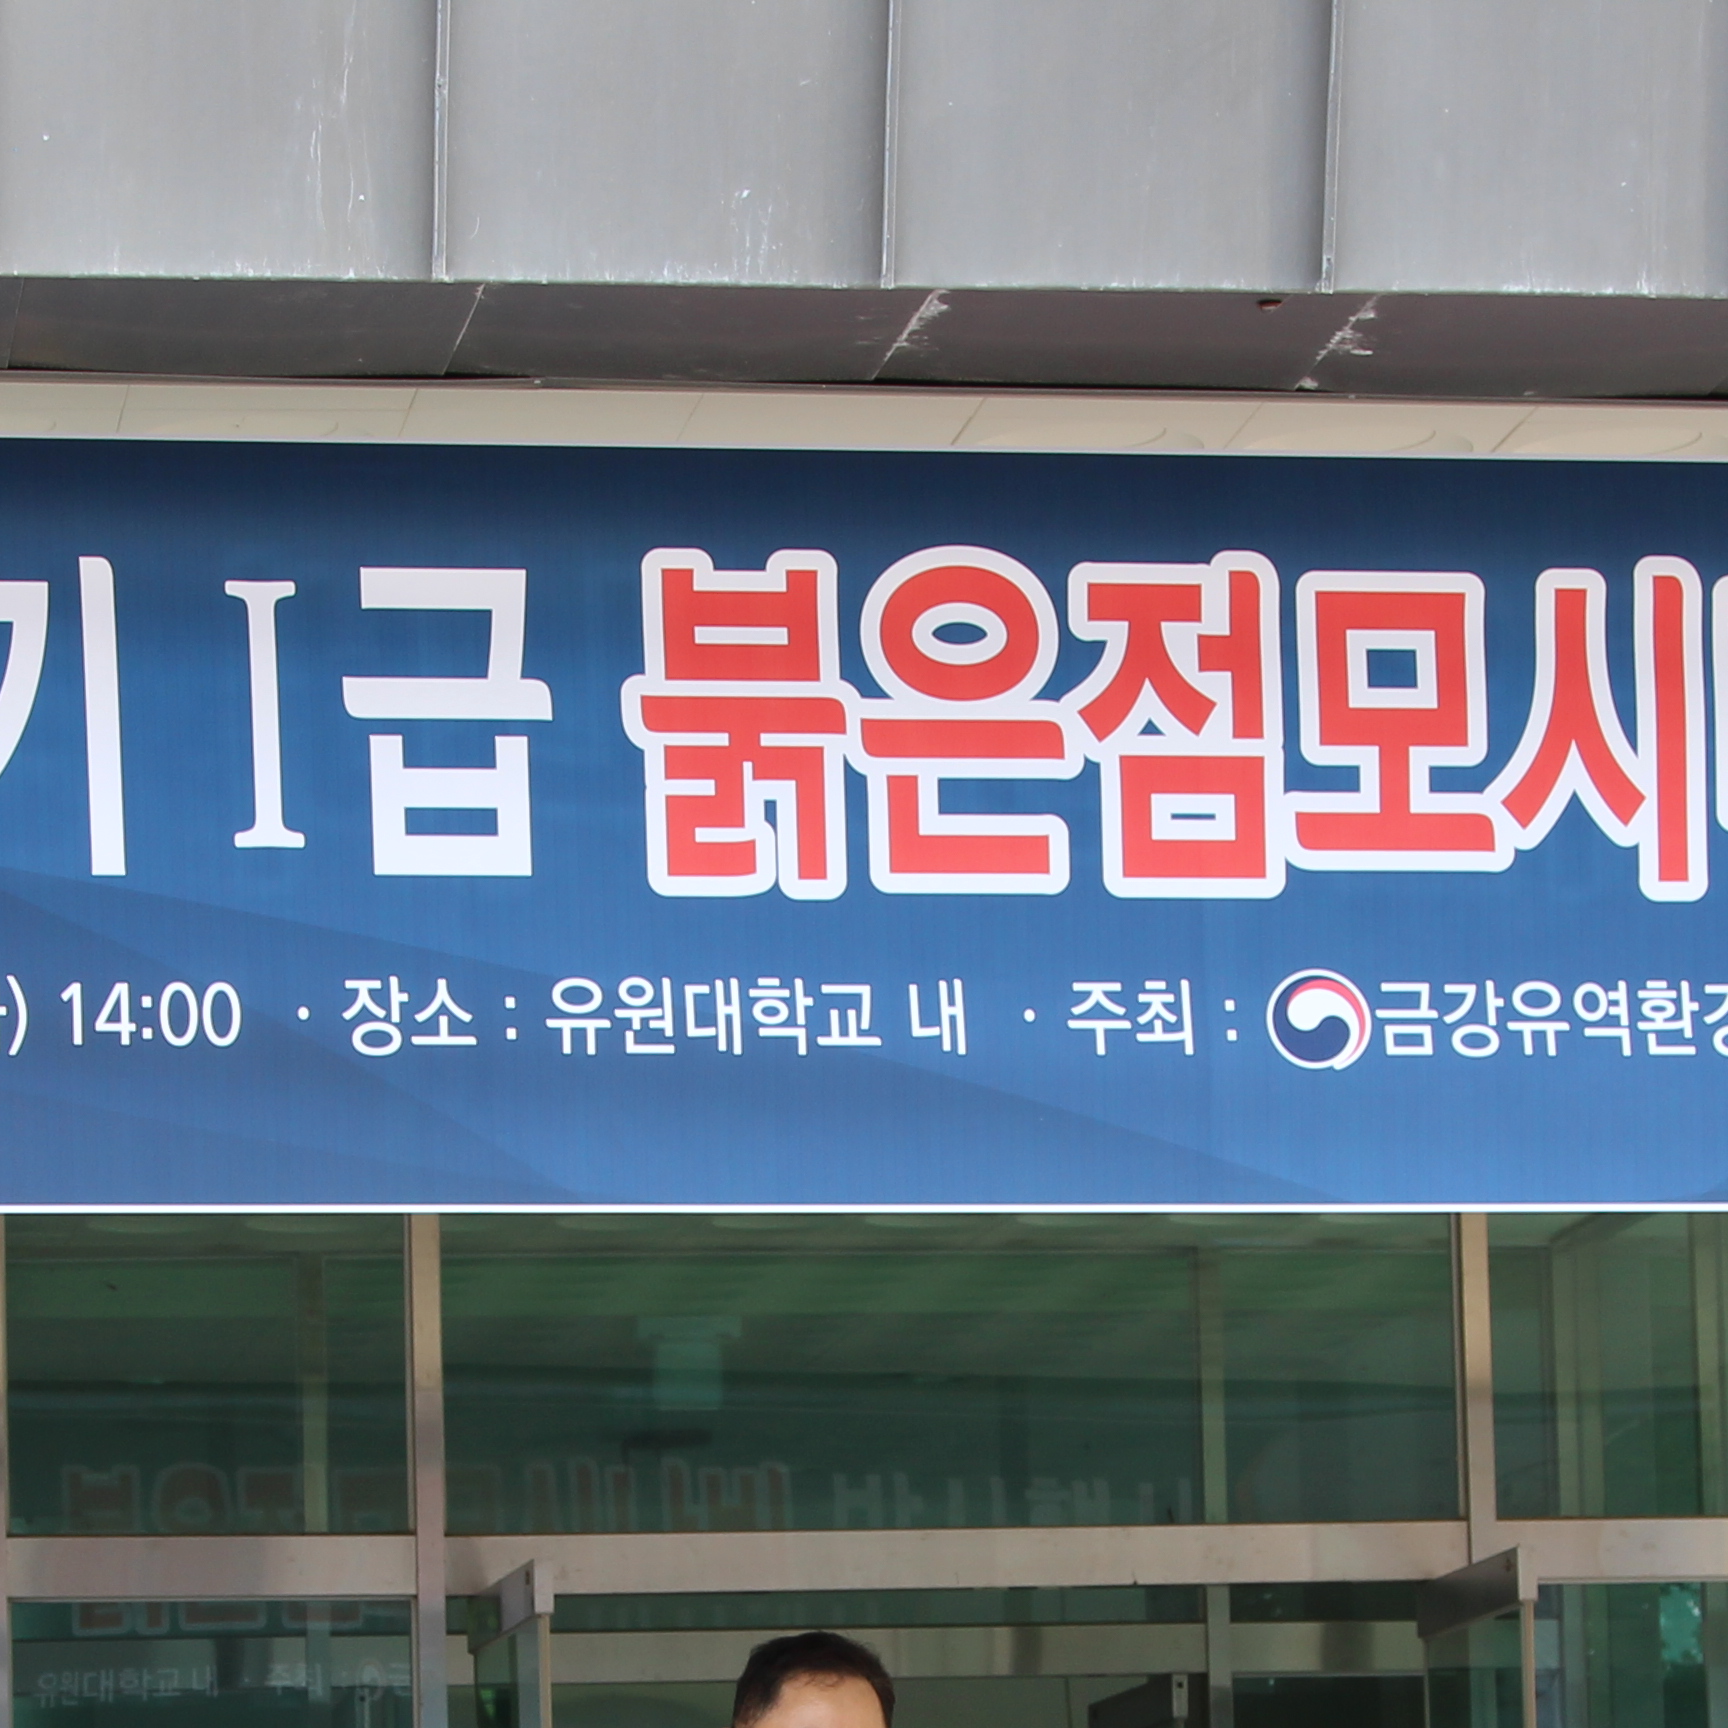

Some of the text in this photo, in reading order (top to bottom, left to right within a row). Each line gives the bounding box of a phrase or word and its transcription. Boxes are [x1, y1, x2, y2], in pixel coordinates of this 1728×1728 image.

[61, 982, 240, 1045] 14:00
[343, 976, 476, 1055] 장소
[546, 977, 881, 1055] 유원대학교
[909, 979, 966, 1054] 내
[1068, 980, 1193, 1055] 주최
